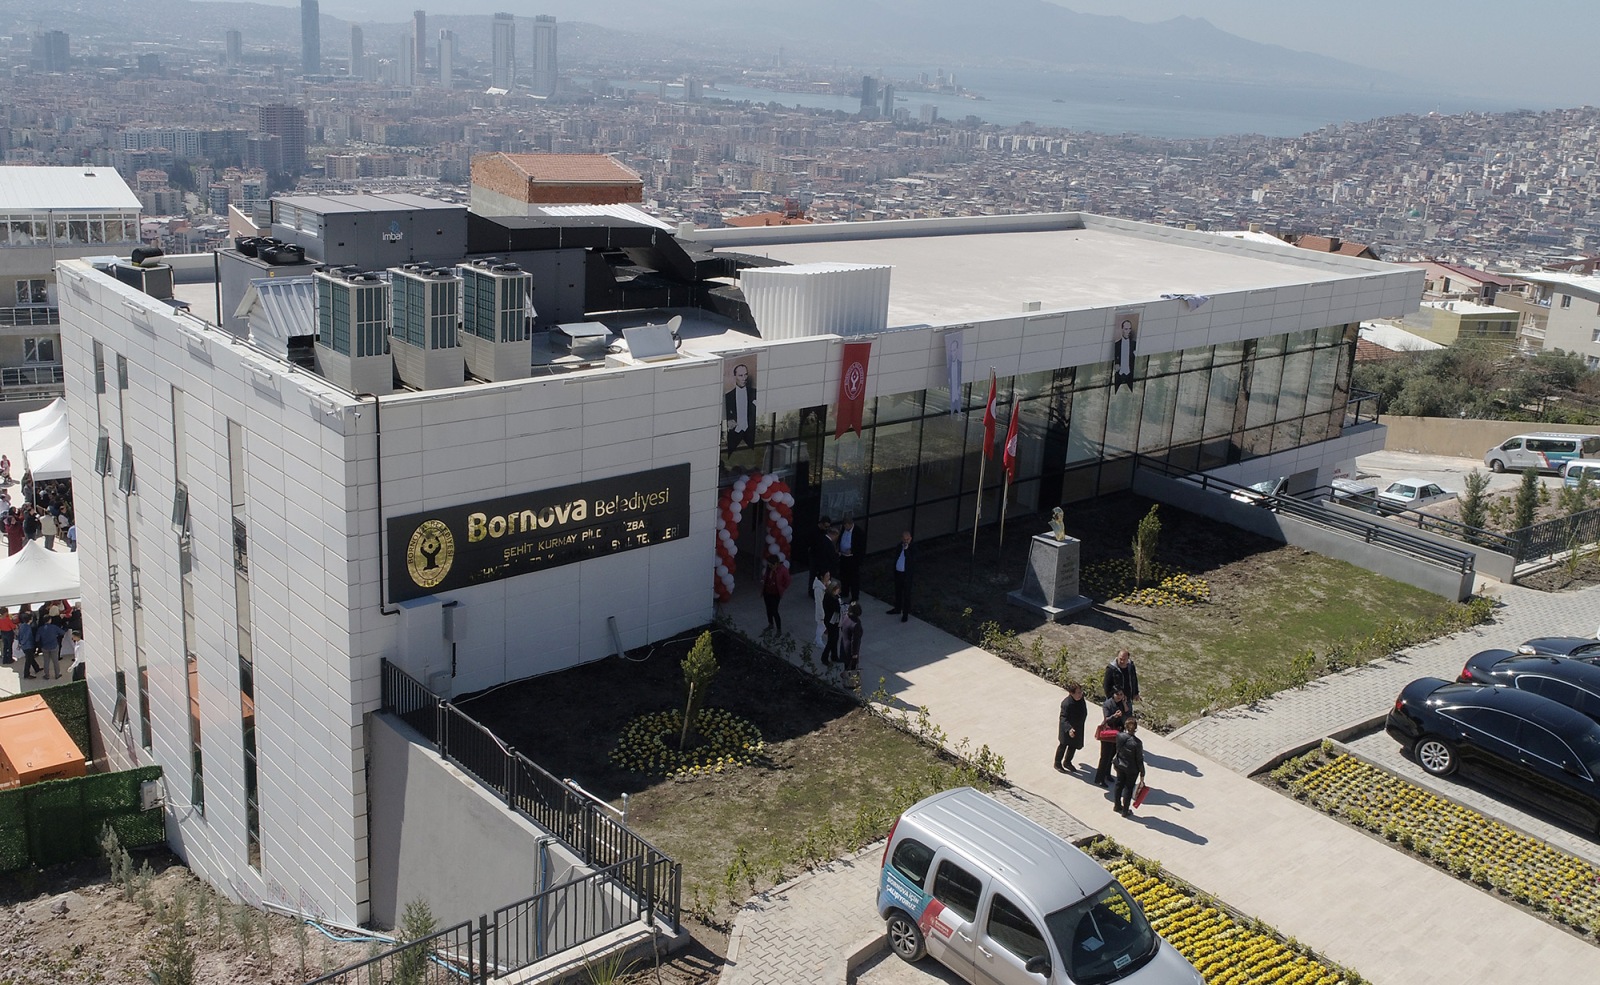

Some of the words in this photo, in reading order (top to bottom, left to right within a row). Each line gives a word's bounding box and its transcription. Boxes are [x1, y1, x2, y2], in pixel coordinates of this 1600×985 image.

[467, 498, 587, 543] Bornova
[595, 487, 670, 517] Belediyesi
[503, 542, 534, 562] ŞEHİT
[538, 533, 578, 551] KURMAY
